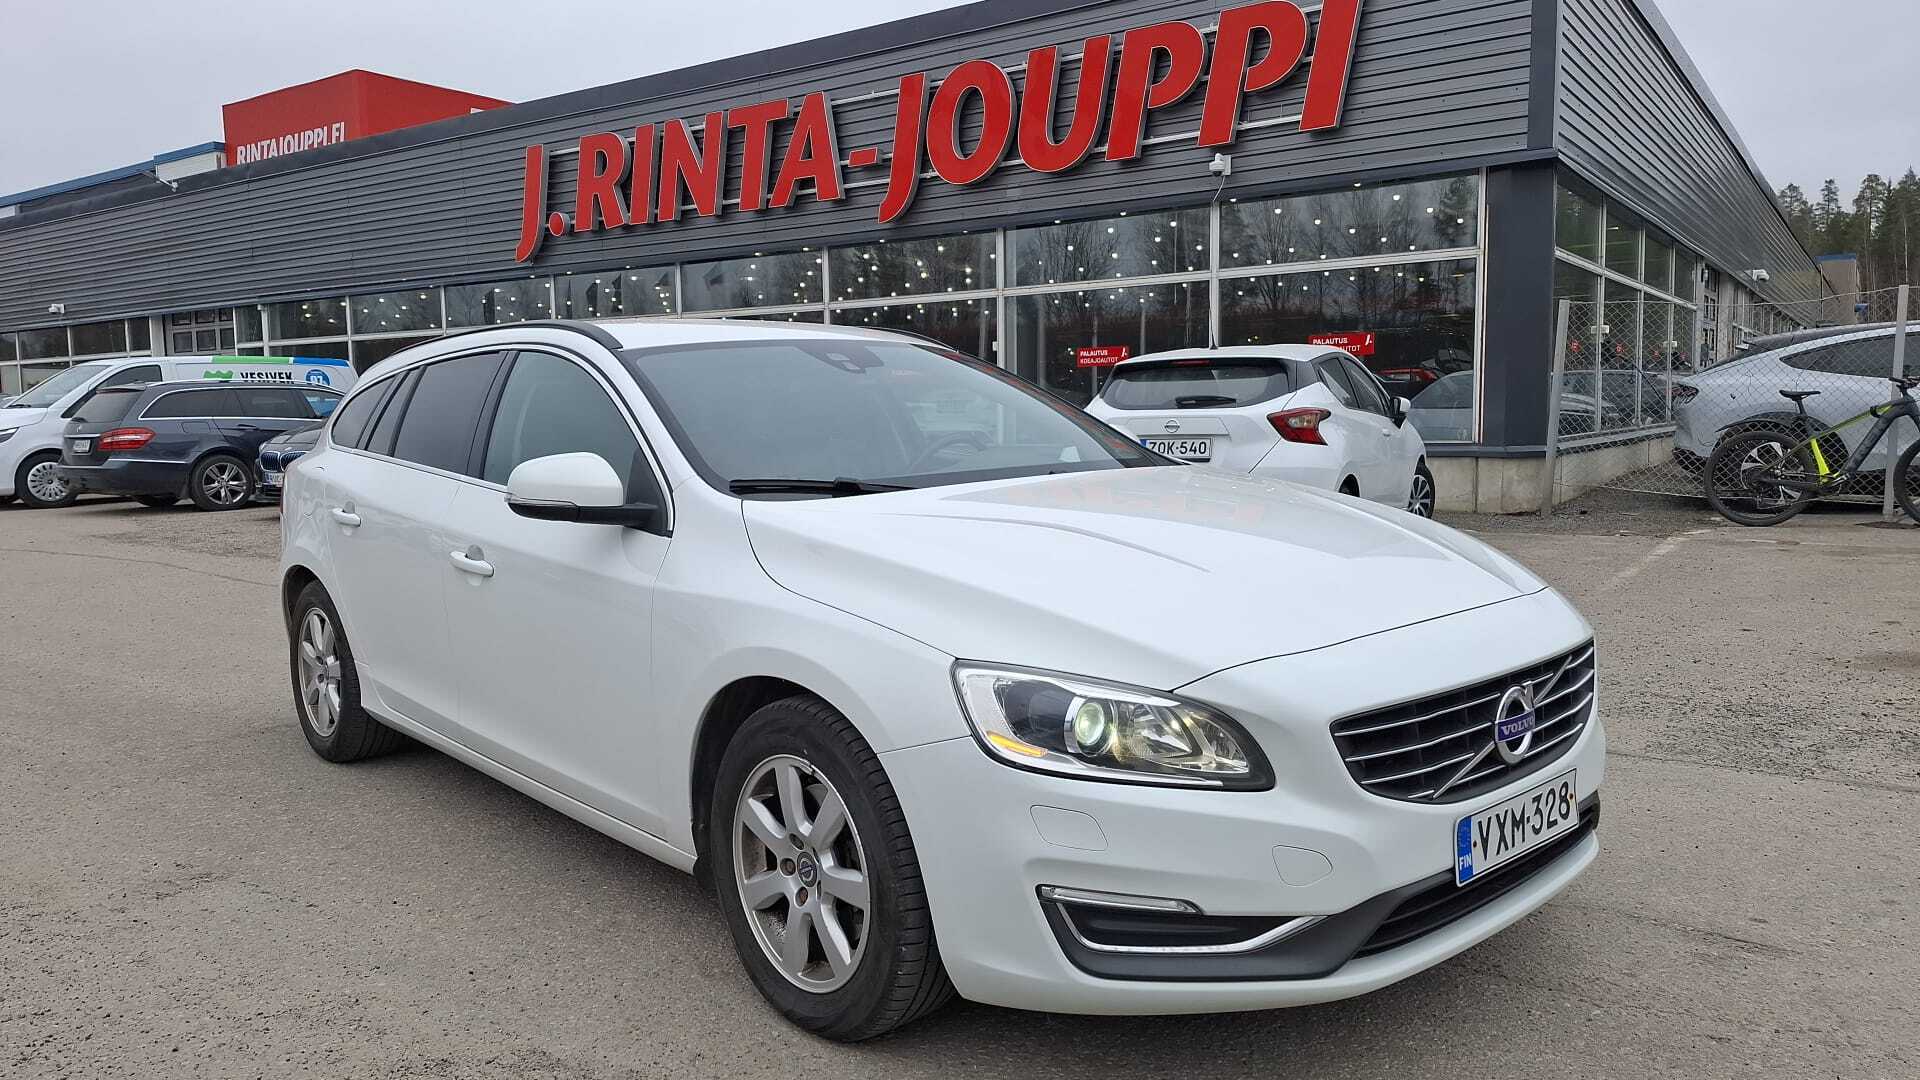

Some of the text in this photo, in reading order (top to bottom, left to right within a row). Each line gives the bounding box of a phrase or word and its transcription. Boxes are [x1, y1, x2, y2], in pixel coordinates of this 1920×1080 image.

[1501, 716, 1534, 735] VOLVO
[1478, 781, 1570, 861] VXM-328
[1460, 853, 1472, 870] FIN
